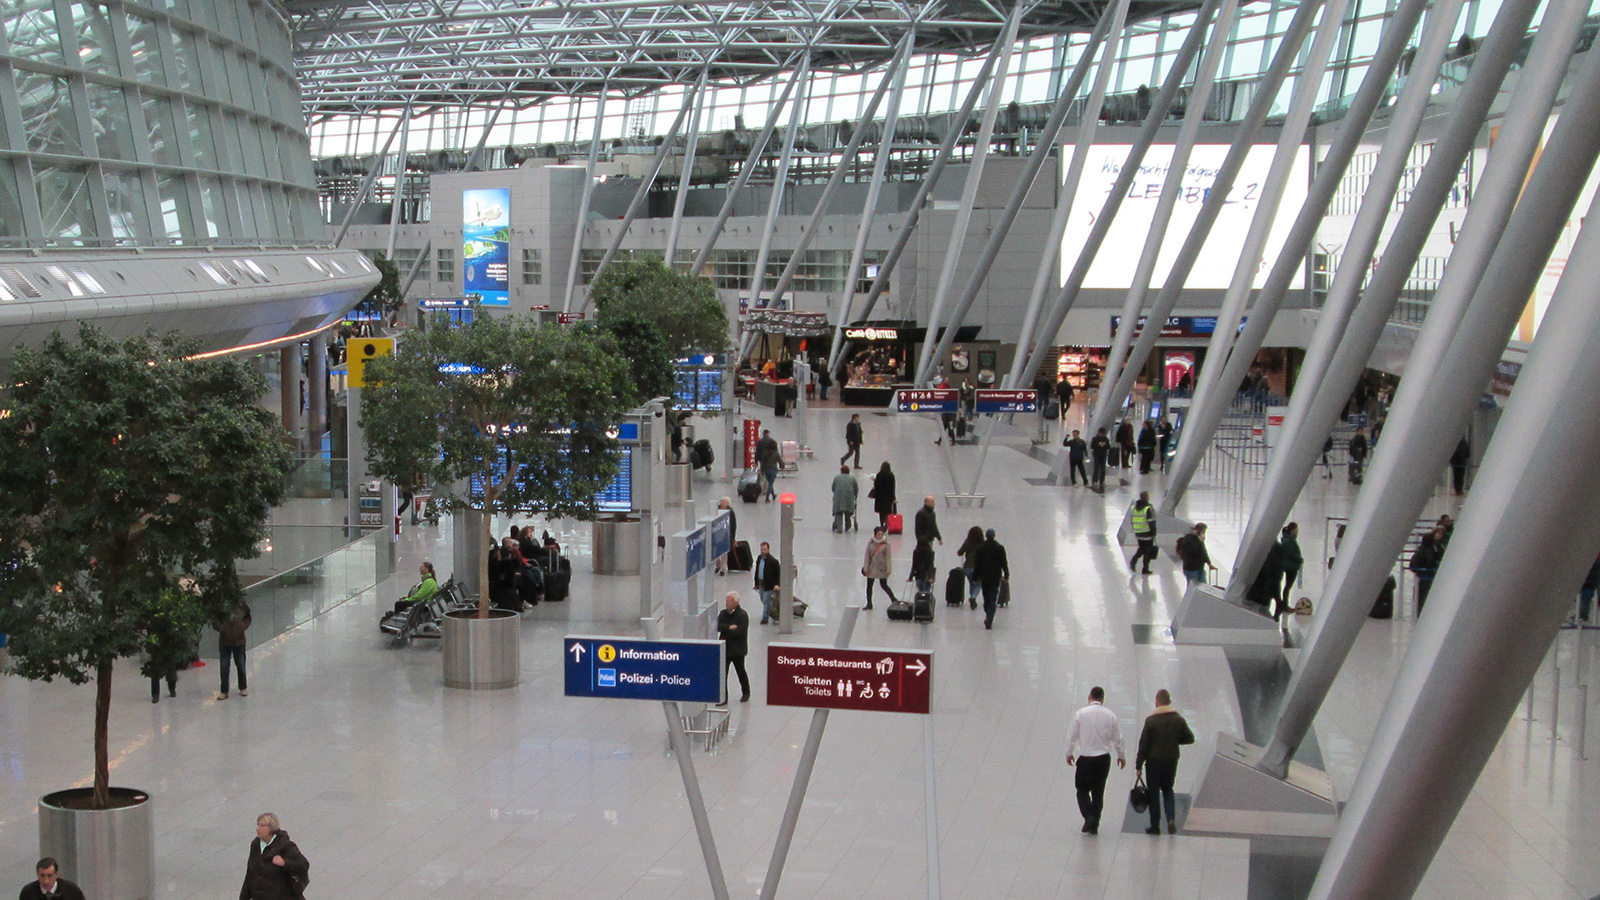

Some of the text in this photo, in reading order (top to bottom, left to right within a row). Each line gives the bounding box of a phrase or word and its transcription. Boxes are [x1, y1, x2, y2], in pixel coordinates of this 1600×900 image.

[619, 649, 680, 661] Information
[777, 655, 872, 669] Shops & Restaurants
[619, 673, 691, 685] Polizei Police
[792, 675, 832, 686] Toiletten
[803, 686, 832, 697] Toilets
